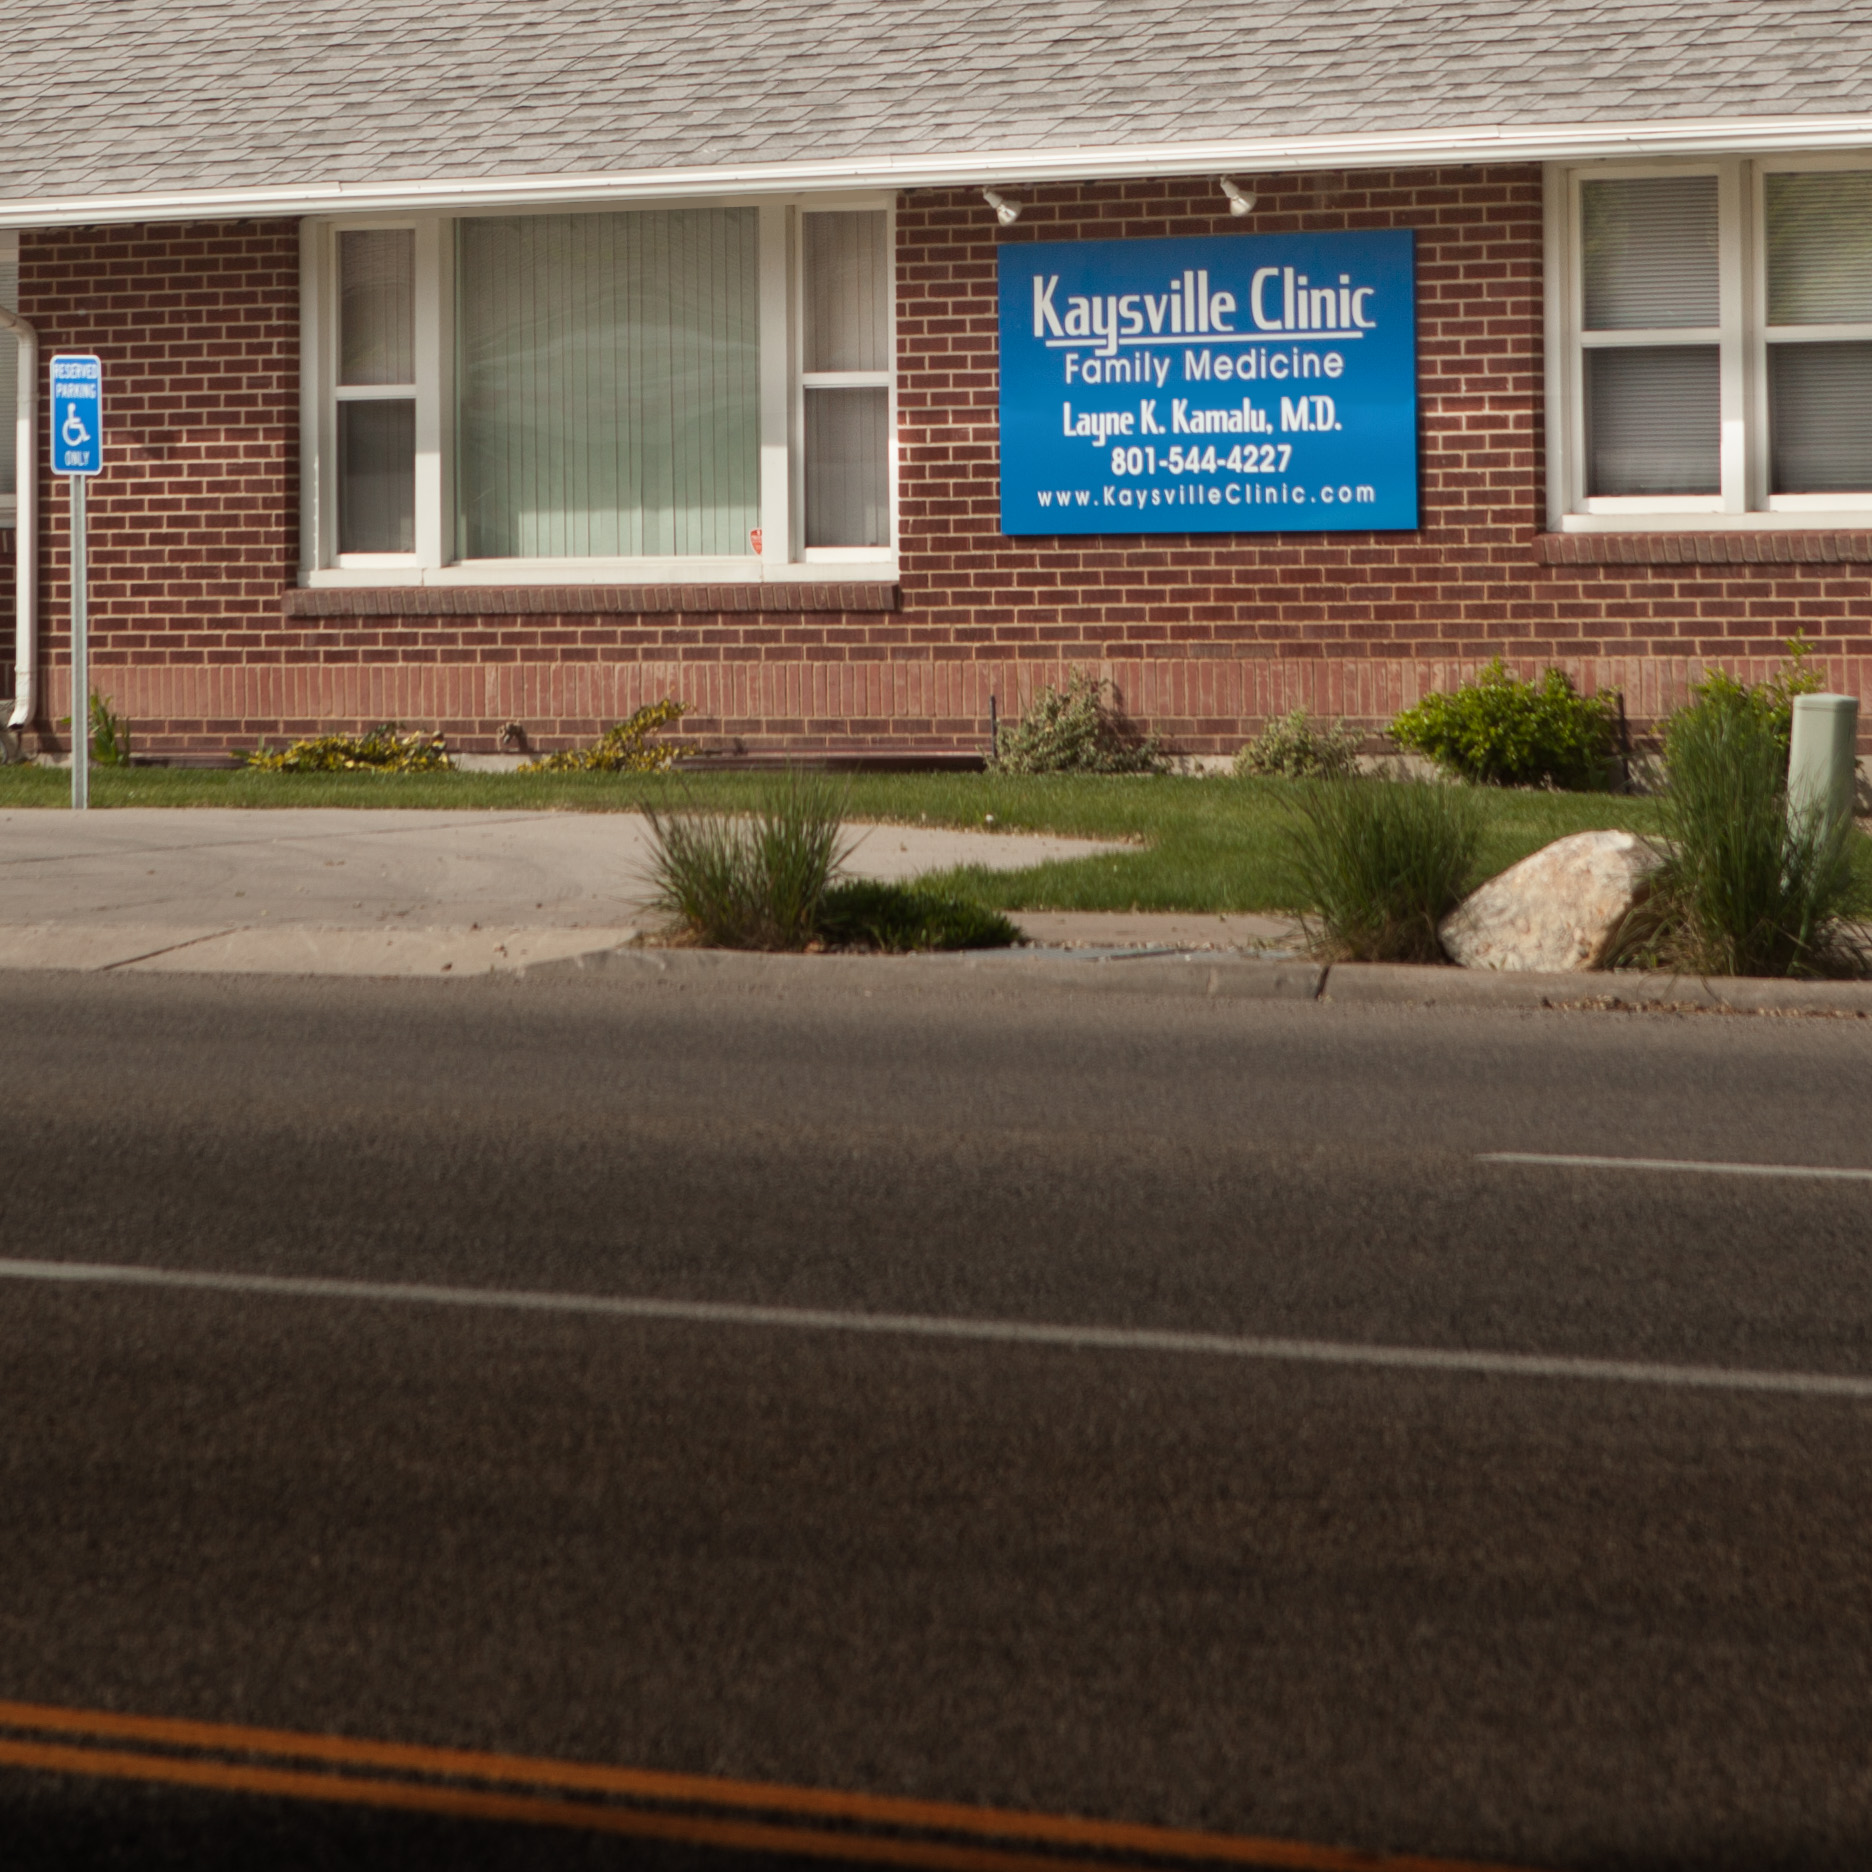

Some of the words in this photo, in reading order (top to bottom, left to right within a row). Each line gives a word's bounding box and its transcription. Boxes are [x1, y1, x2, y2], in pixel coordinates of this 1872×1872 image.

[1032, 270, 1236, 357] Kaysville
[1250, 266, 1377, 331] Clinic
[54, 363, 98, 379] RESERVED
[1065, 350, 1170, 388] Family
[1185, 347, 1345, 381] Medicine
[56, 383, 96, 399] PARKING
[1063, 402, 1135, 447] Layne
[1140, 399, 1167, 436] K.
[1172, 398, 1274, 434] Kamalu,
[1280, 395, 1343, 432] M.D.
[64, 450, 90, 466] ONLY
[1111, 445, 1292, 475] 801-544-4227
[1037, 483, 1377, 510] www.KaysvilleClinic.com
